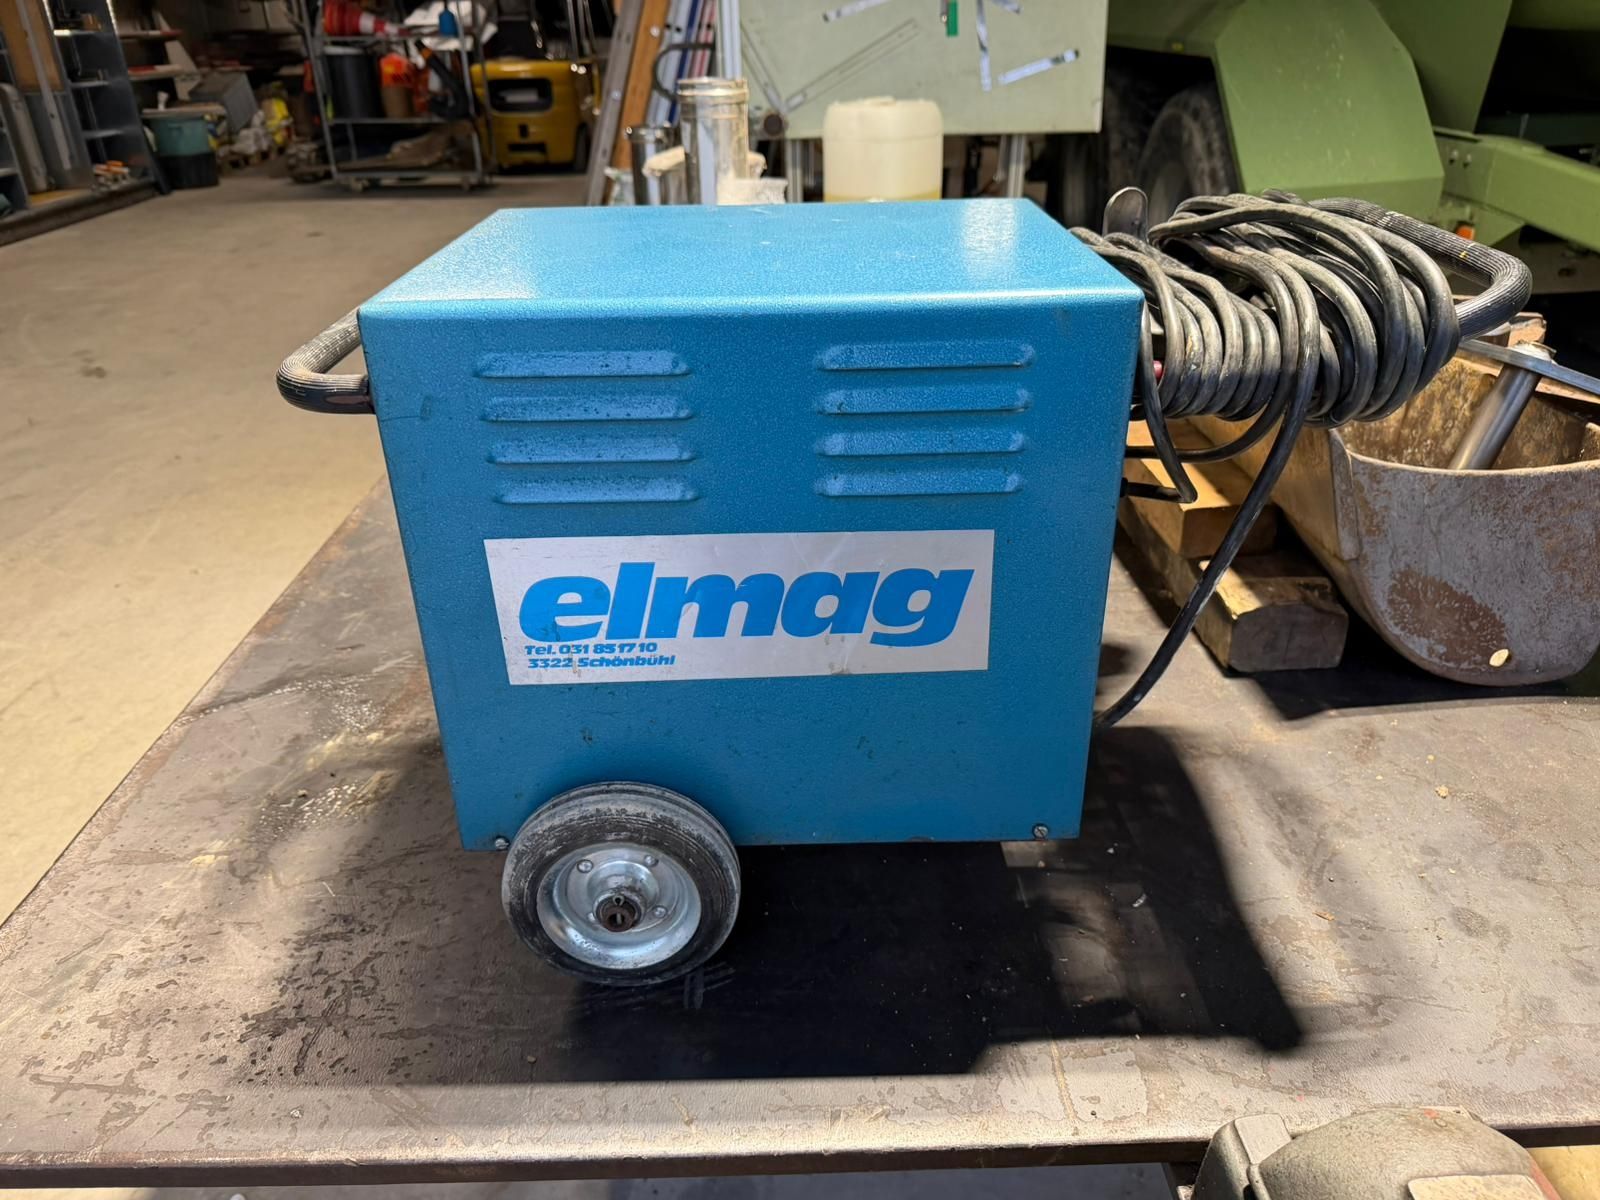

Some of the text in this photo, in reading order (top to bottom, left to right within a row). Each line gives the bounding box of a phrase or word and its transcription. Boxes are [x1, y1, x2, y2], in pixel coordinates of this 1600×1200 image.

[519, 562, 975, 648] elmag
[524, 643, 556, 656] Tel.
[558, 643, 590, 655] 031
[527, 654, 677, 669] 3322 Schönbühl
